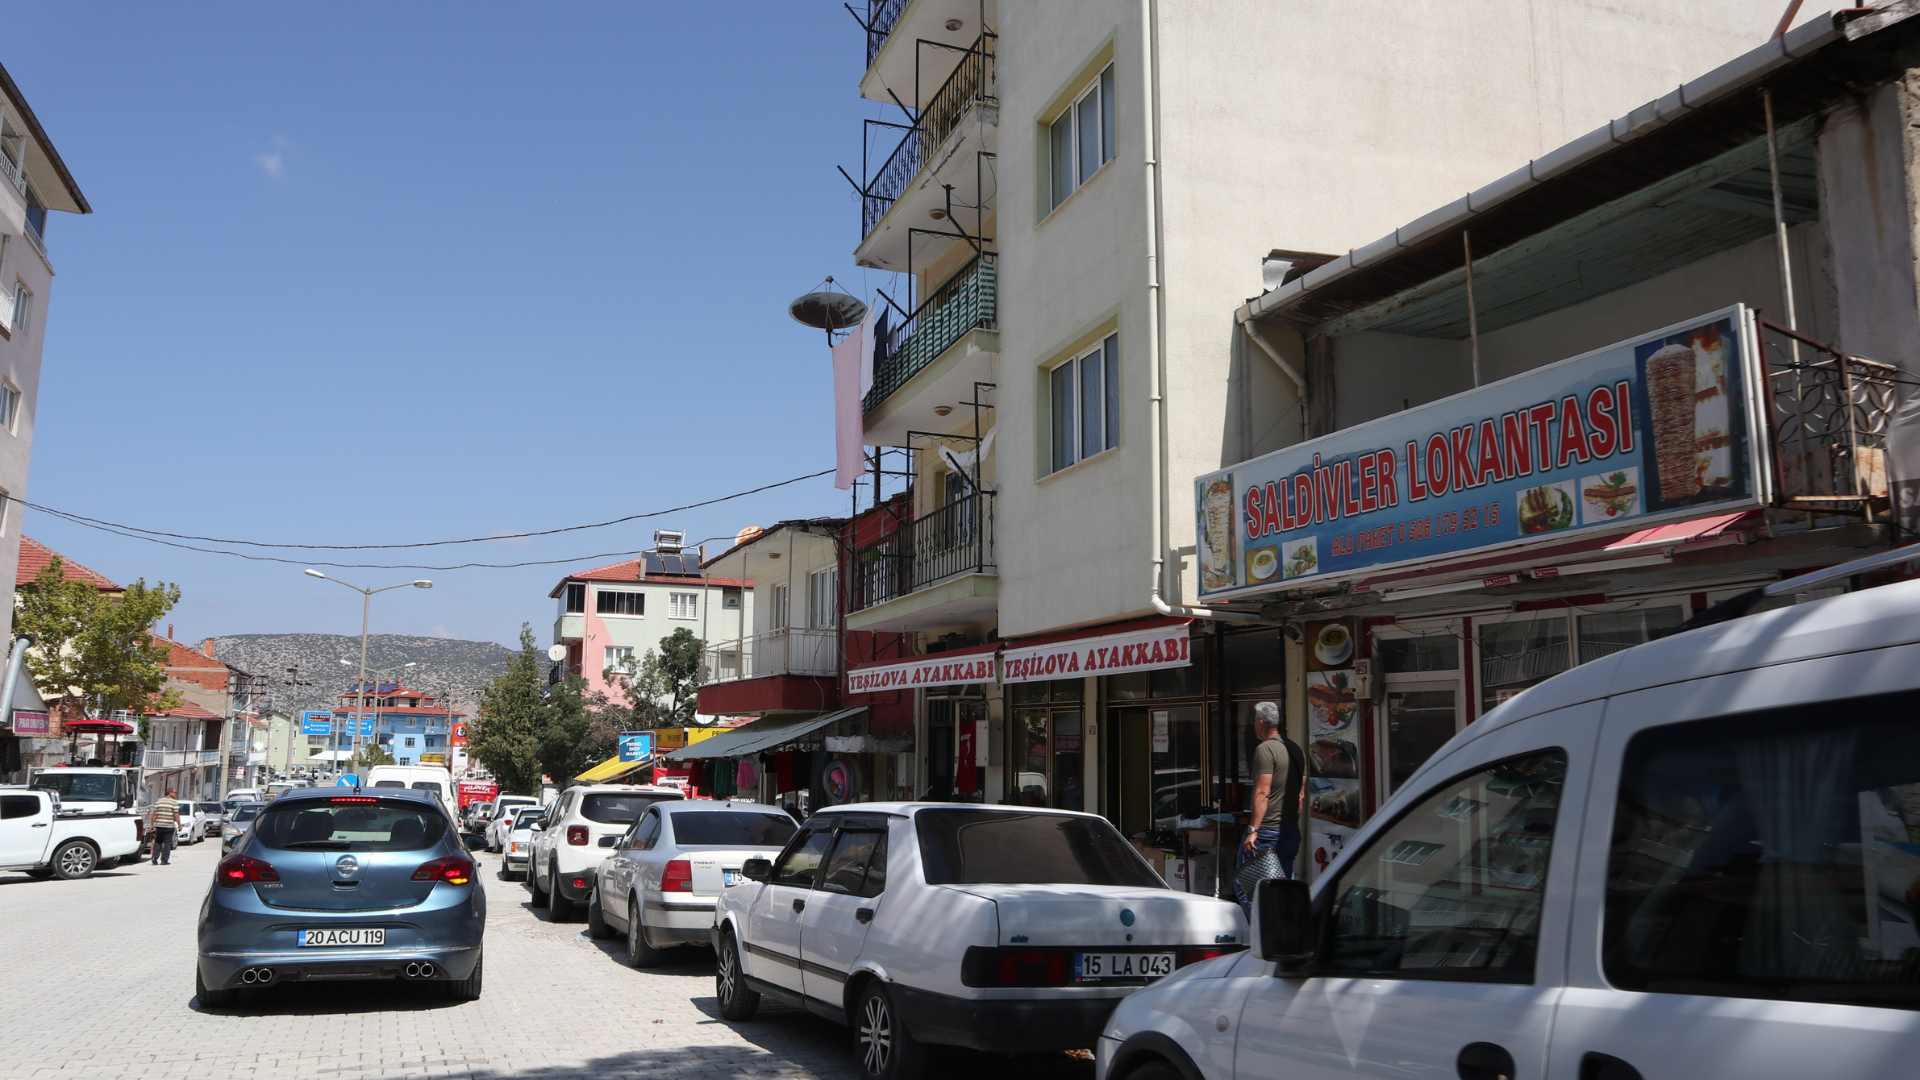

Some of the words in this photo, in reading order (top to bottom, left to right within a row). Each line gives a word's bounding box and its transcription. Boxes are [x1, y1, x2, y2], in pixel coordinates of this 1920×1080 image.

[1246, 451, 1398, 540] SALDİVLER
[1406, 381, 1634, 503] LOKANTASI
[1004, 652, 1079, 681] YEŞİLOVA
[1084, 637, 1189, 670] AYAKKABI
[849, 667, 907, 693] YEŞİLOVA
[911, 660, 994, 688] AYAKKABI
[307, 931, 323, 945] 20
[327, 931, 360, 944] ACU
[364, 930, 383, 943] 119
[1084, 956, 1102, 975] 15
[1112, 955, 1133, 976] LA
[1139, 955, 1171, 975] 043
